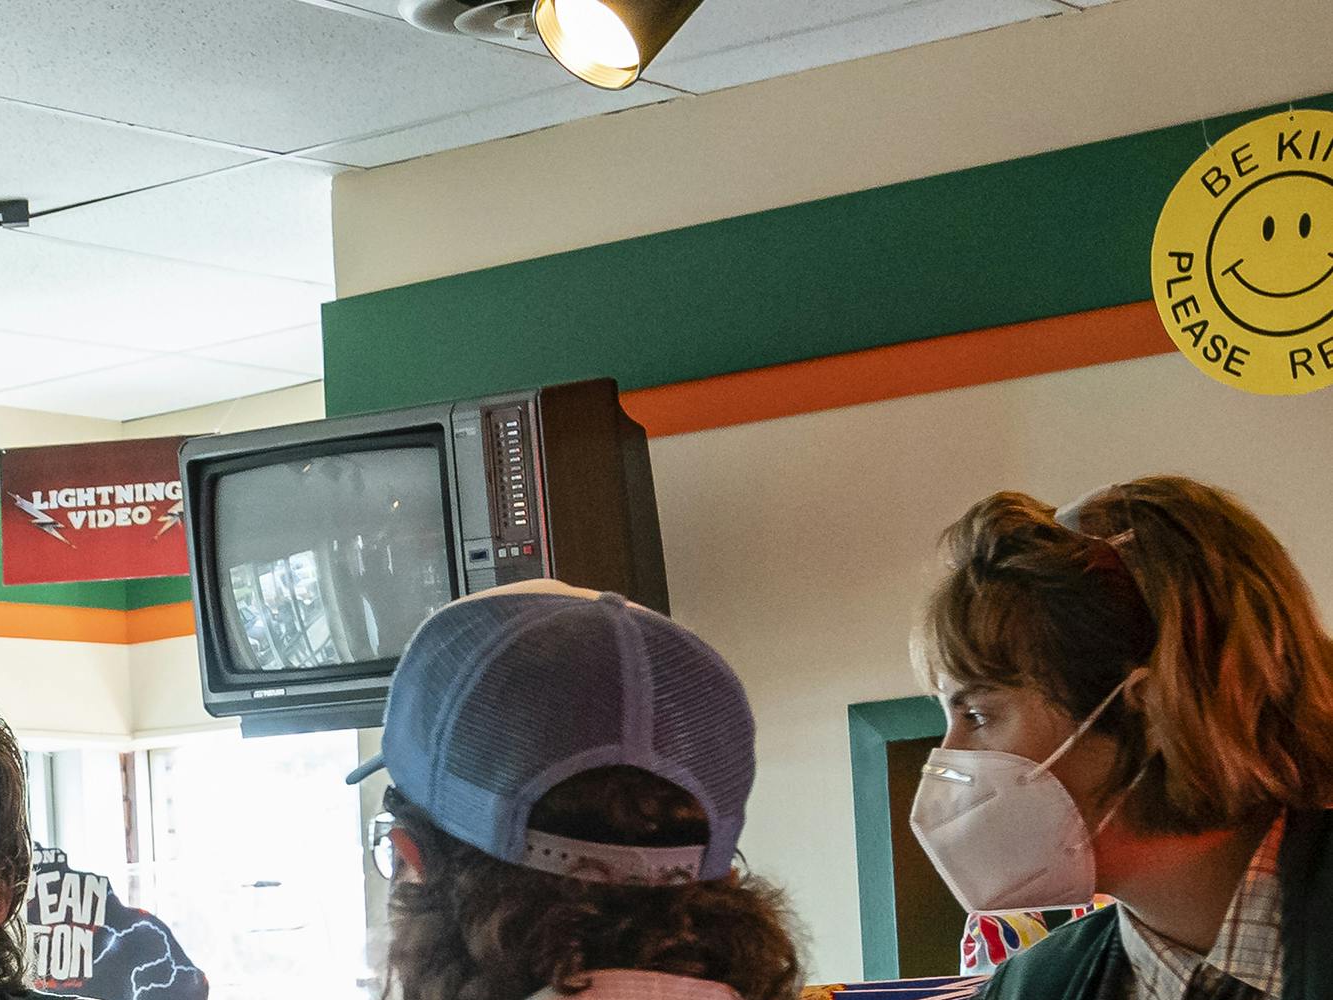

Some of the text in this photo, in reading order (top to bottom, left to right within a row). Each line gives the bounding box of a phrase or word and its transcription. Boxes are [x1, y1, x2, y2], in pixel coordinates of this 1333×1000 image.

[1201, 143, 1259, 198] BE
[1166, 251, 1251, 377] PLEASE
[32, 481, 182, 510] LIGHTNING
[67, 506, 151, 530] VIDEO
